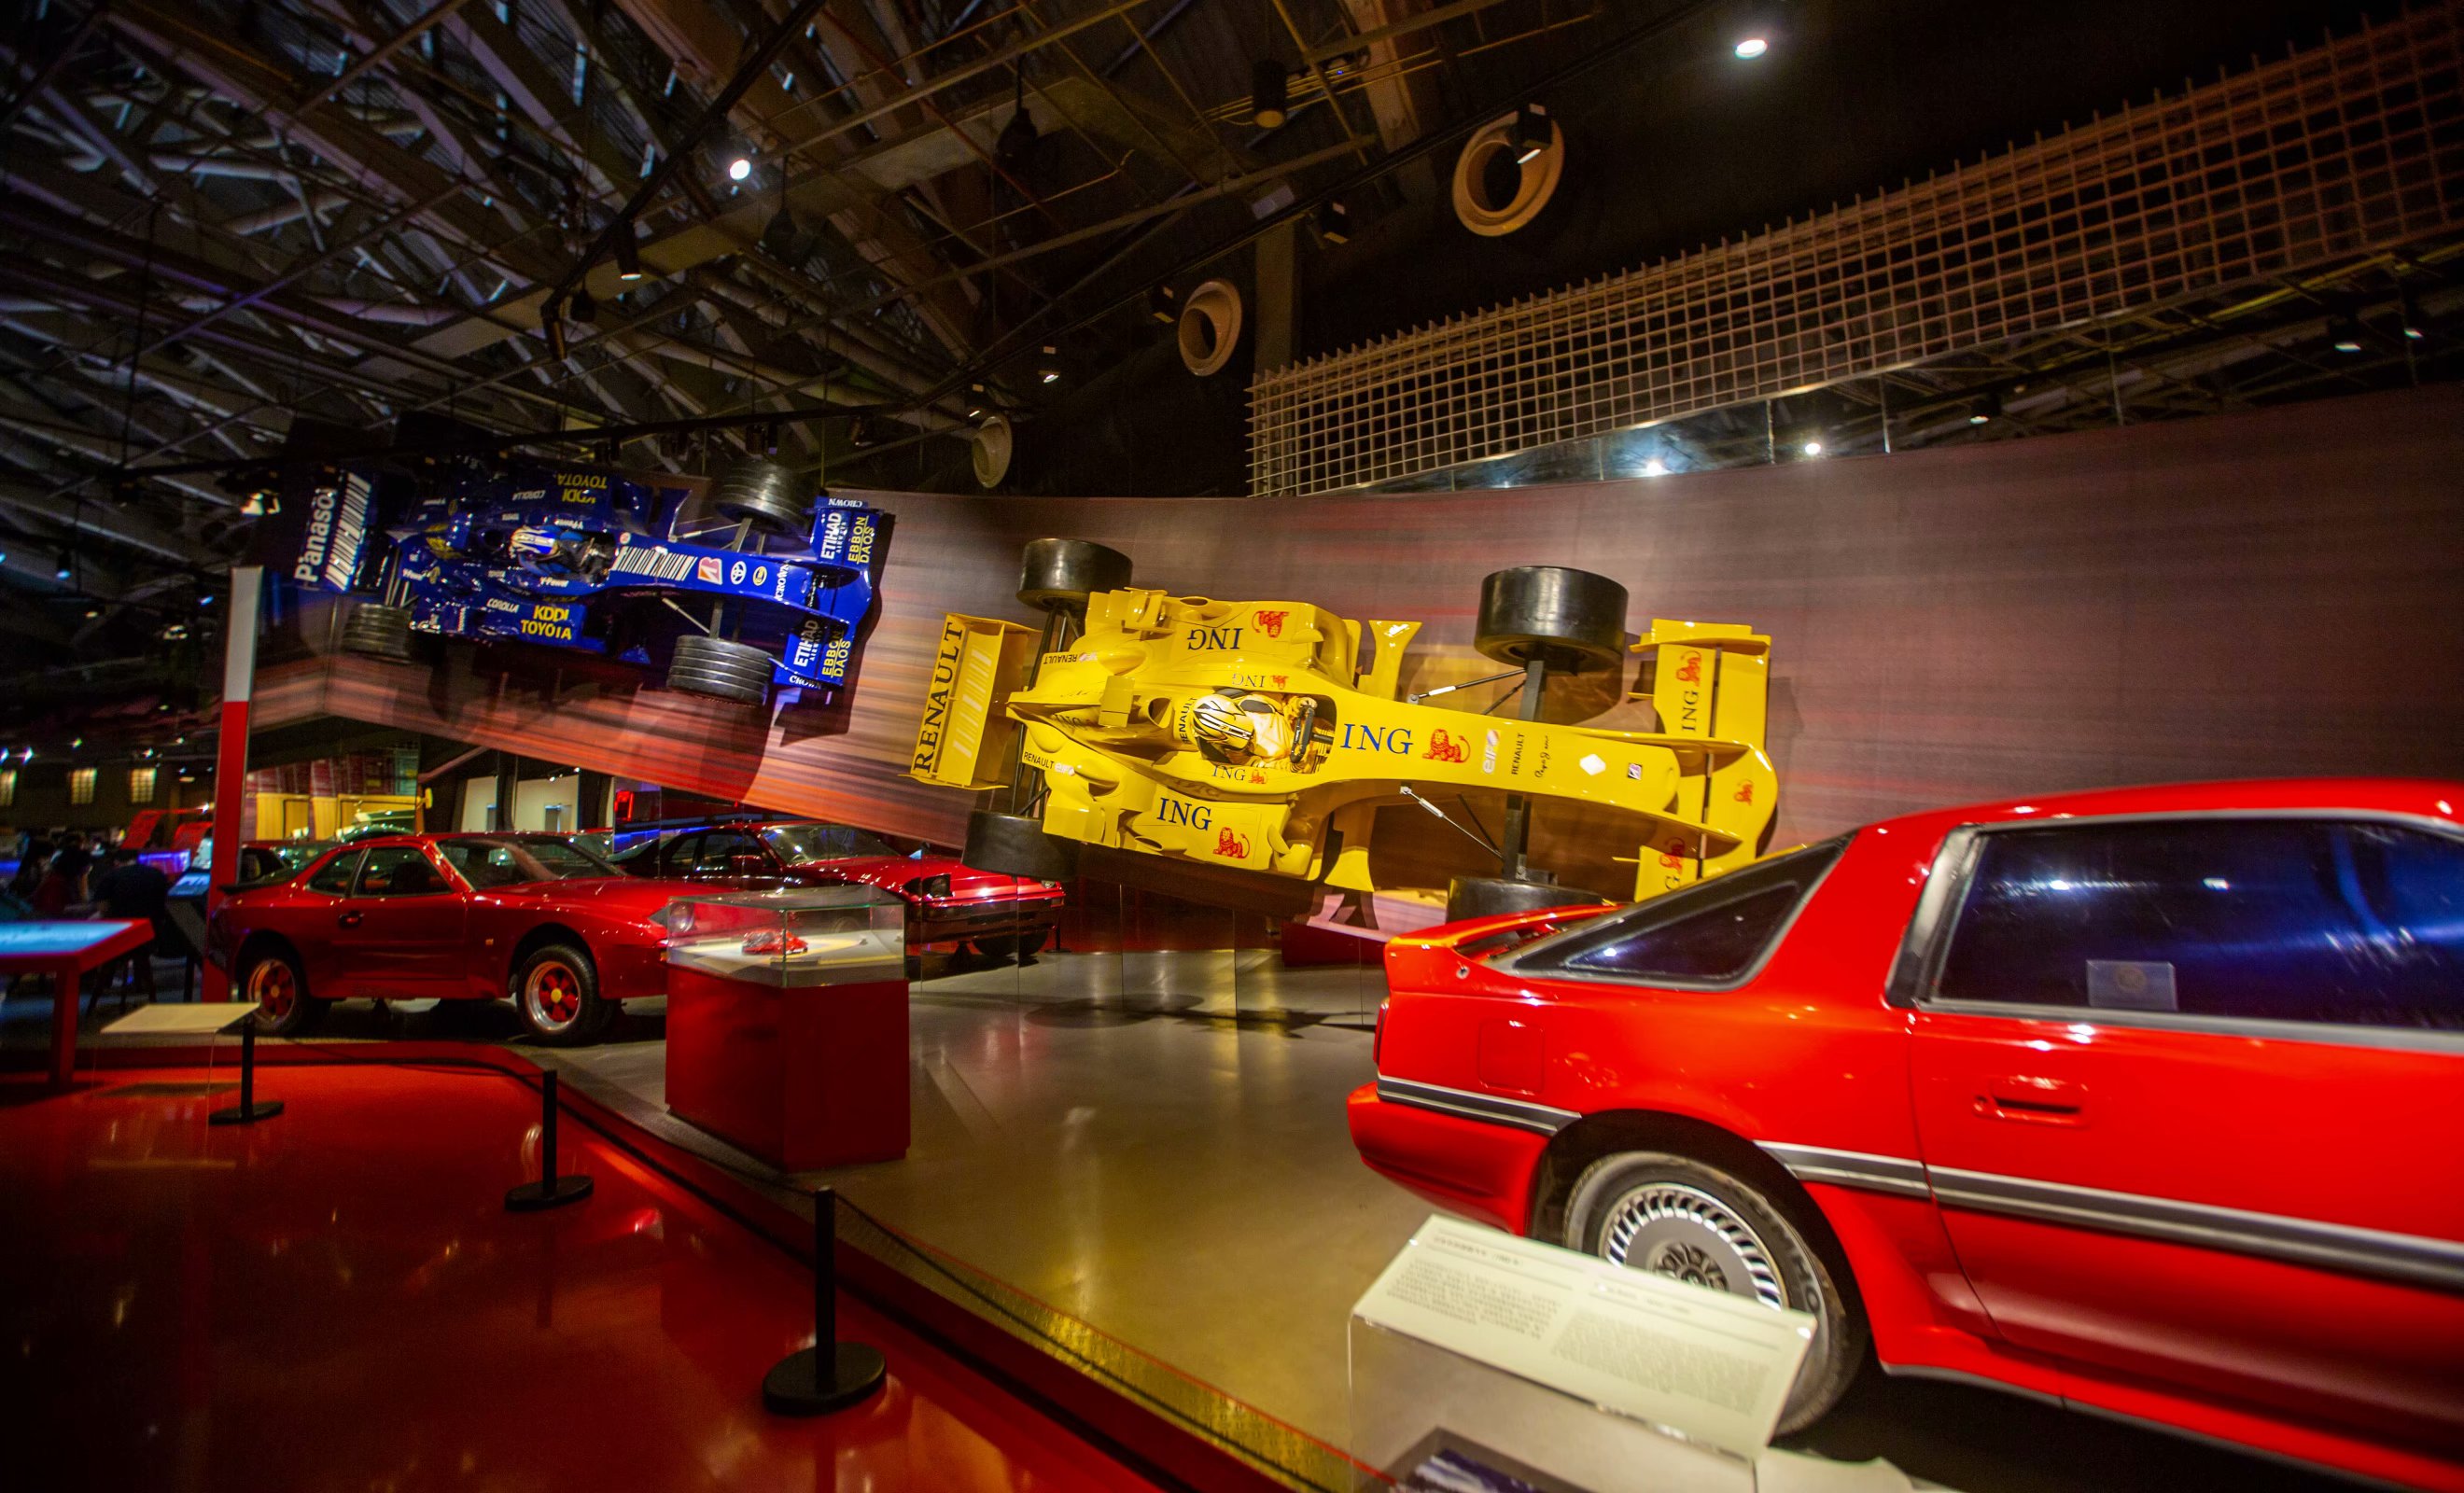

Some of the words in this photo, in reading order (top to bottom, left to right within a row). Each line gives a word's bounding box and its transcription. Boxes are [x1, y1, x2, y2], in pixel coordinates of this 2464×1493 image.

[557, 473, 608, 489] TOYOTA
[828, 497, 863, 508] CROWN
[294, 488, 335, 582] Panaso
[819, 512, 842, 560] ETIHAD
[847, 516, 867, 562] EBBON
[859, 526, 875, 564] DAOS
[486, 598, 521, 613] COROLLA
[533, 605, 569, 622] KDDI
[793, 620, 819, 667] ETIHAD
[1186, 627, 1244, 650] ING
[833, 640, 851, 677] DAOS
[1043, 654, 1078, 665] RENAULT
[1232, 673, 1267, 688] ING
[913, 621, 963, 774] RENAULT
[1681, 691, 1700, 732] ING
[1340, 723, 1414, 755] ING
[1511, 733, 1525, 775] RENAULT
[1023, 751, 1055, 770] RENAULT
[1211, 764, 1246, 781] ING
[1156, 797, 1212, 831] ING
